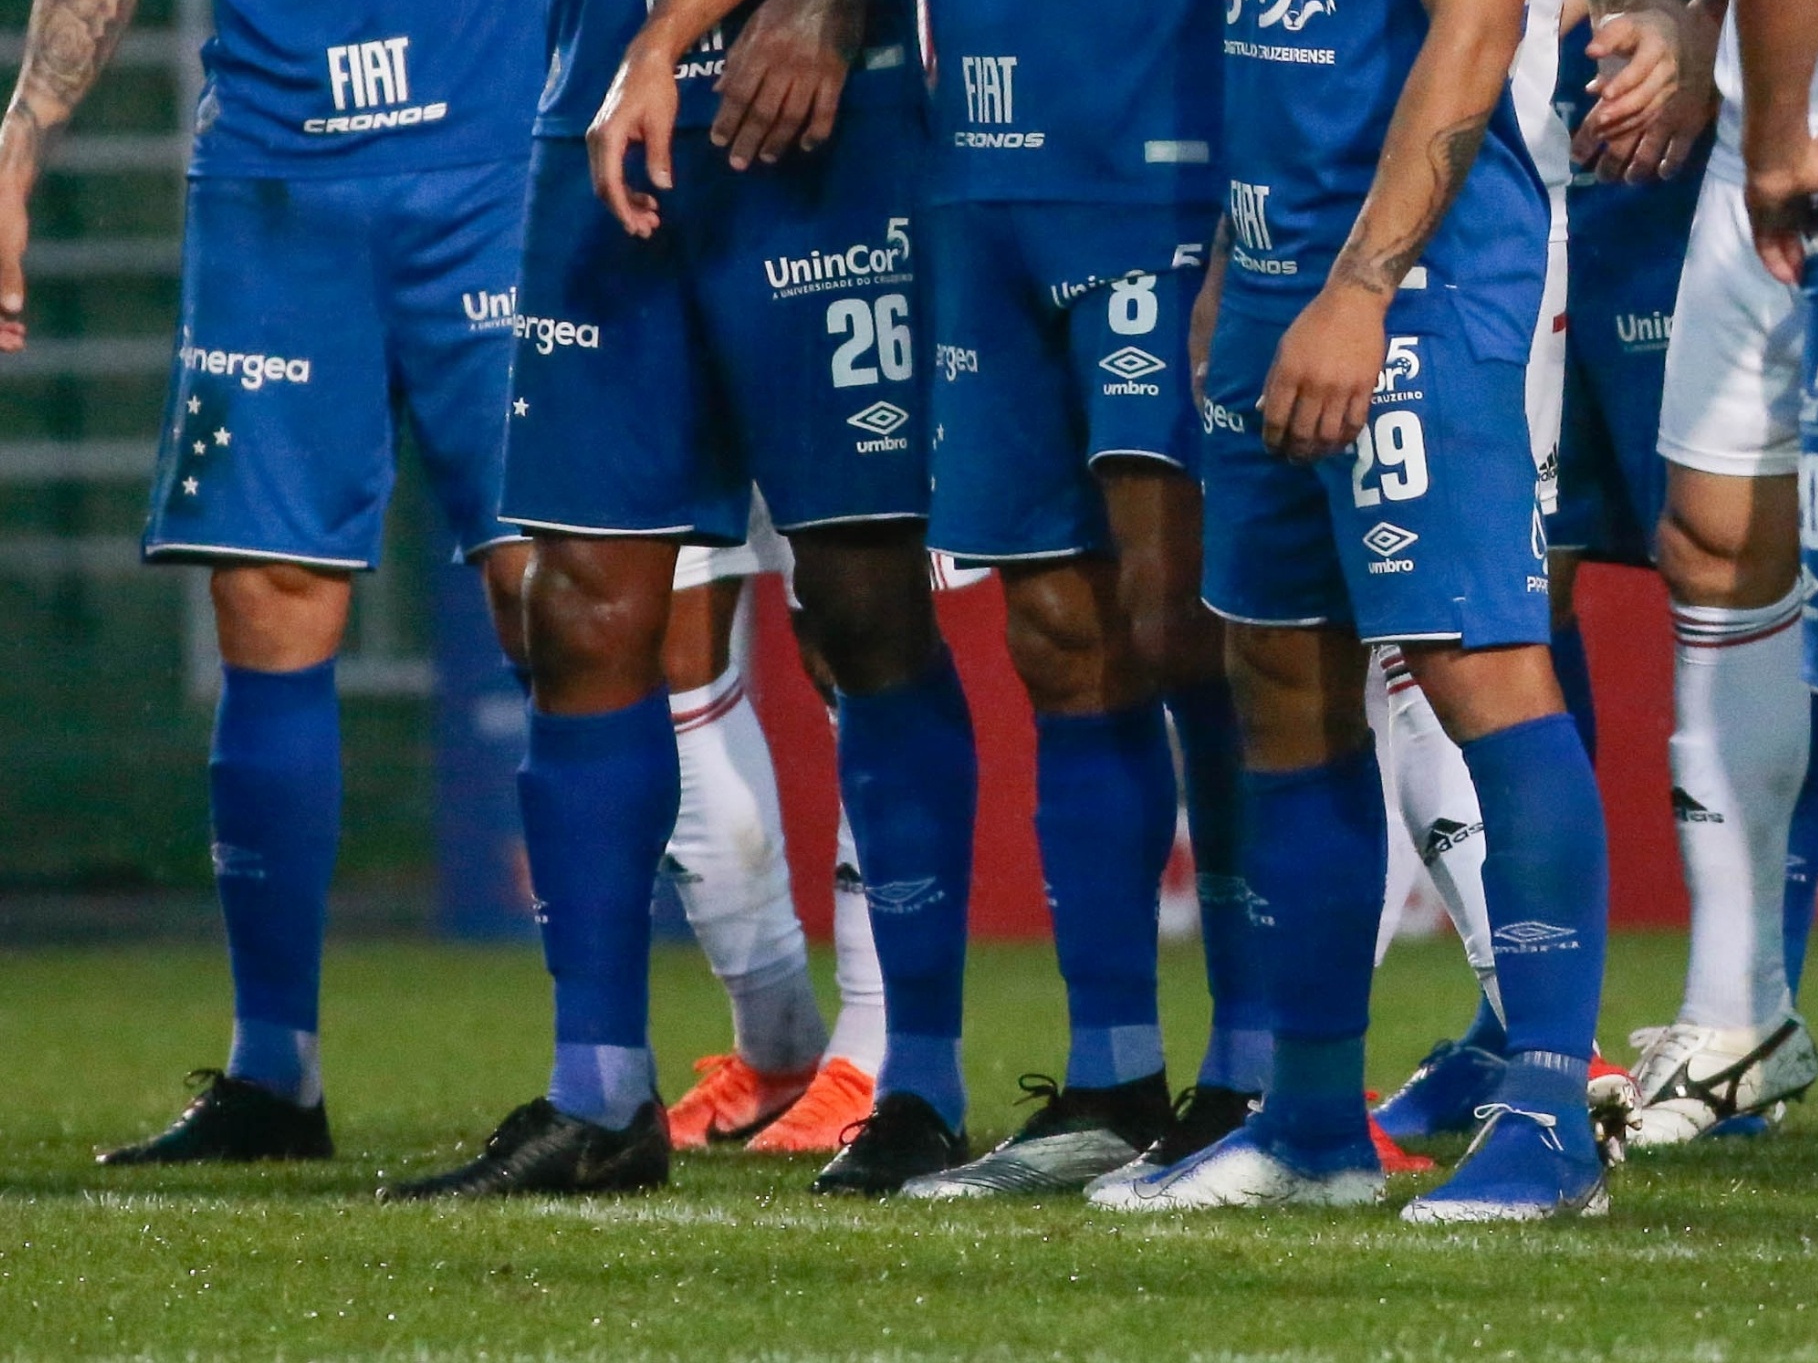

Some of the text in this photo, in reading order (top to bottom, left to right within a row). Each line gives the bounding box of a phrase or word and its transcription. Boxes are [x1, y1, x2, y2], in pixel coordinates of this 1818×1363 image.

[327, 36, 410, 111] FIAT
[962, 56, 1018, 124] FIAT
[303, 101, 449, 134] CRONOS
[954, 131, 1046, 149] CRONOS
[1230, 179, 1273, 251] FIAT
[1107, 269, 1158, 336] 8
[826, 293, 914, 388] 26
[1103, 379, 1160, 397] umbro
[856, 435, 909, 454] umbro
[1368, 557, 1414, 575] umbro
